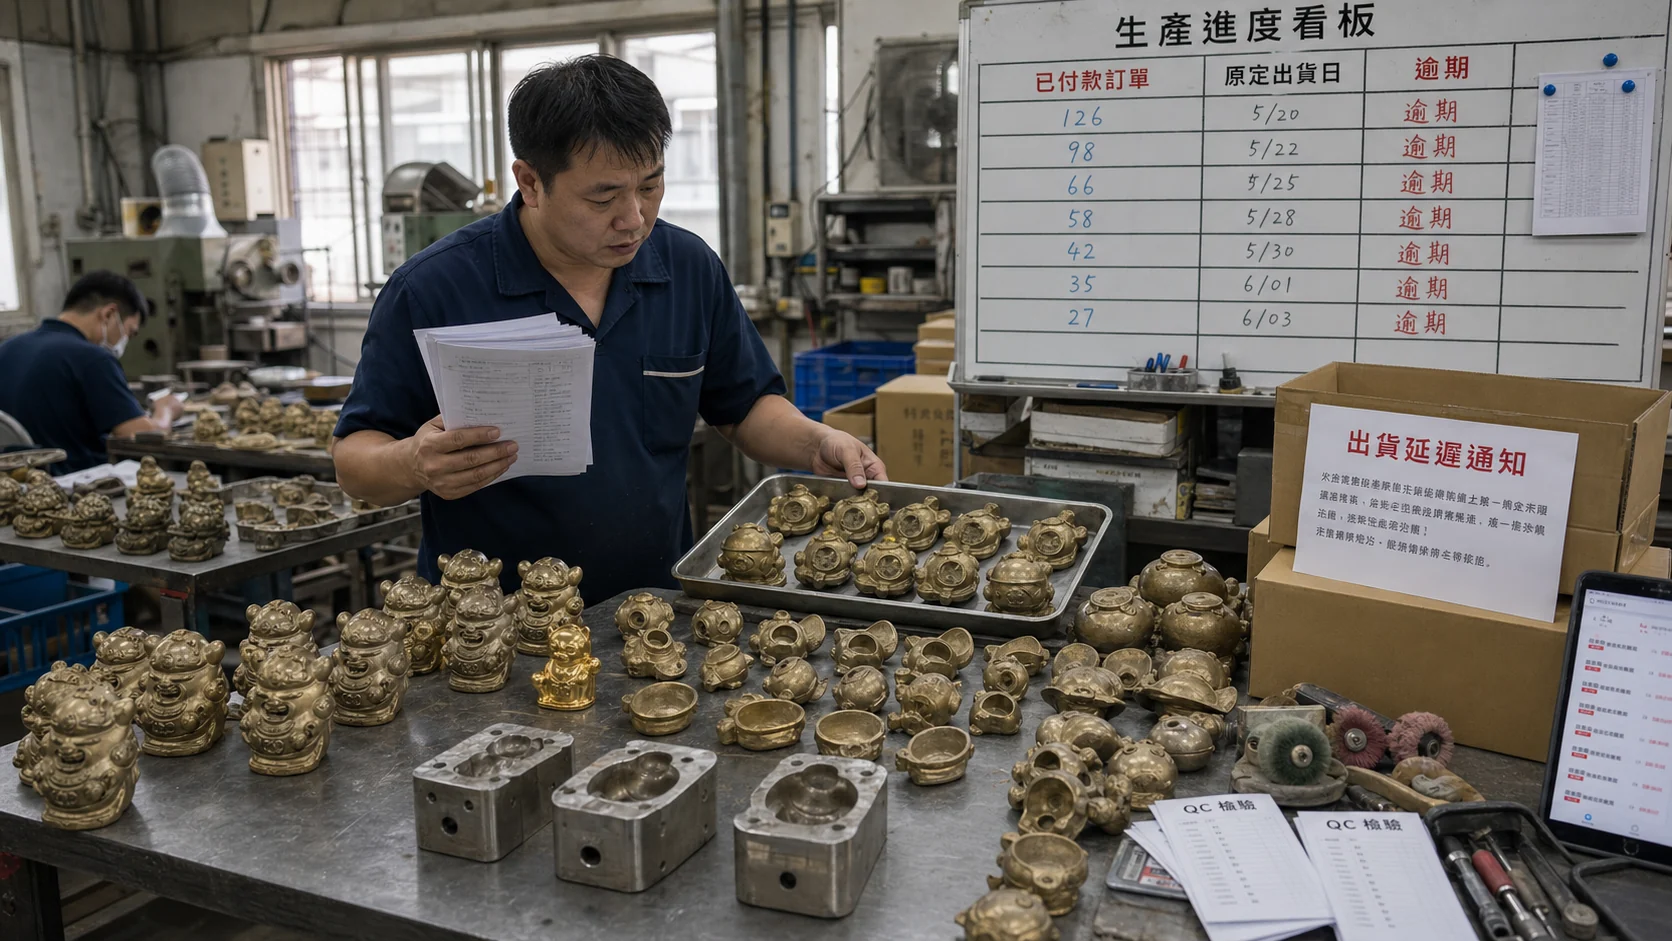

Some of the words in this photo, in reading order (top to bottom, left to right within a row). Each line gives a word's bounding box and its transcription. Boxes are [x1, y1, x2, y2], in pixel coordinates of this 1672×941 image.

[1114, 2, 1376, 49] 生產進度看板
[1224, 61, 1340, 87] 原定出貨日
[1414, 55, 1470, 81] 逾期
[1035, 67, 1150, 93] 已付款訂單
[1063, 106, 1103, 127] 126
[1252, 103, 1300, 125] 5/20
[1404, 98, 1457, 125] 逾期
[1068, 141, 1095, 164] 98
[1248, 138, 1299, 160] 5/22
[1402, 133, 1456, 160] 逾期
[1067, 175, 1094, 196] 66
[1247, 172, 1300, 194] 5/25
[1400, 169, 1454, 196] 逾期
[1068, 208, 1093, 229] 58
[1246, 207, 1296, 229] 5/28
[1399, 204, 1452, 231] 逾期
[1066, 241, 1095, 261] 42
[1246, 241, 1294, 263] 5/30
[1396, 240, 1450, 267] 逾期
[1068, 274, 1097, 294] 35
[1244, 274, 1292, 296] 6/01
[1396, 275, 1448, 301] 逾期
[1067, 307, 1095, 328] 27
[1242, 308, 1292, 330] 6/03
[1394, 309, 1447, 336] 逾期
[1347, 428, 1527, 477] 出貨延遲通知
[1183, 803, 1212, 814] QC
[1326, 819, 1357, 831] QC
